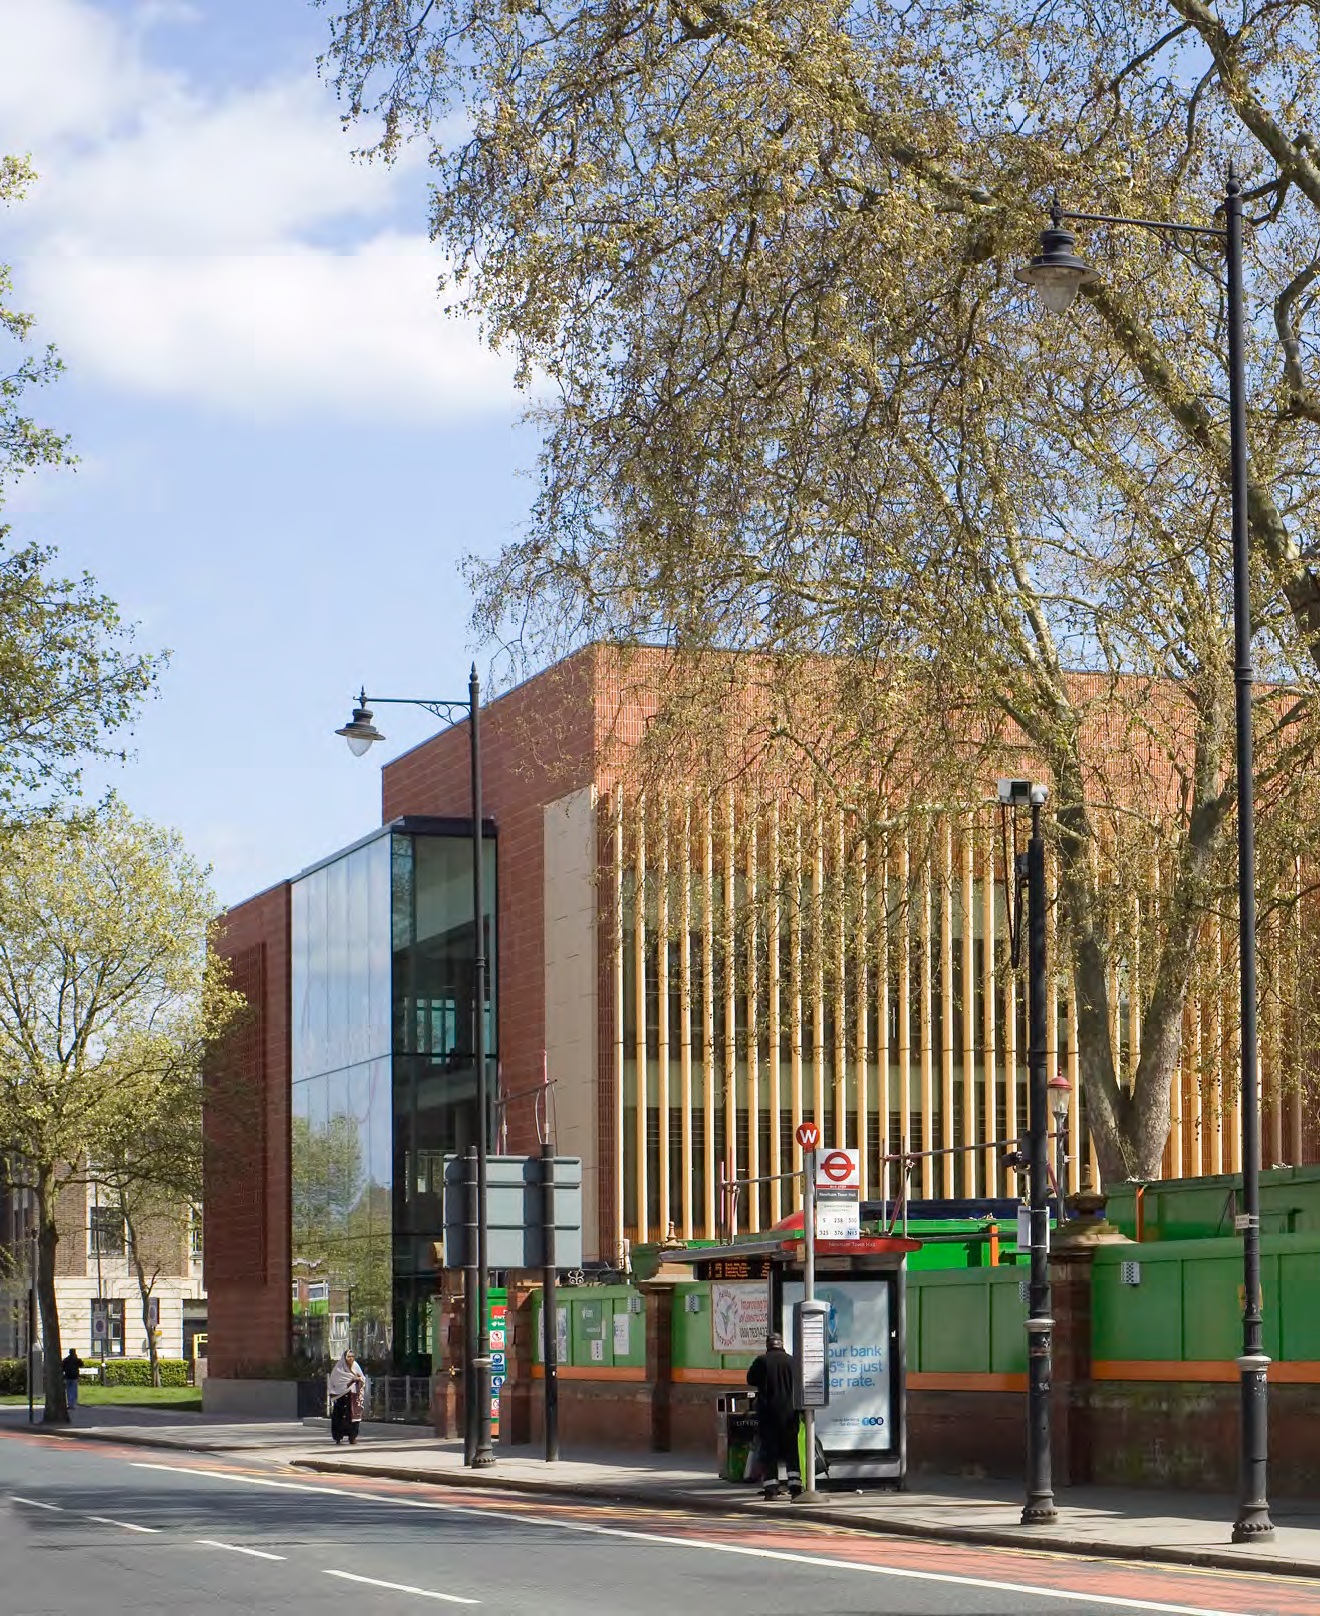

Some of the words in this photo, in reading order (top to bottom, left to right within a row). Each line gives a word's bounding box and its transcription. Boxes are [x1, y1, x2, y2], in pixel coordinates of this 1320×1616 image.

[799, 1129, 817, 1144] W
[829, 1348, 847, 1358] our
[850, 1344, 881, 1357] bank
[847, 1361, 858, 1372] is
[859, 1360, 882, 1375] just
[847, 1375, 875, 1387] rate.
